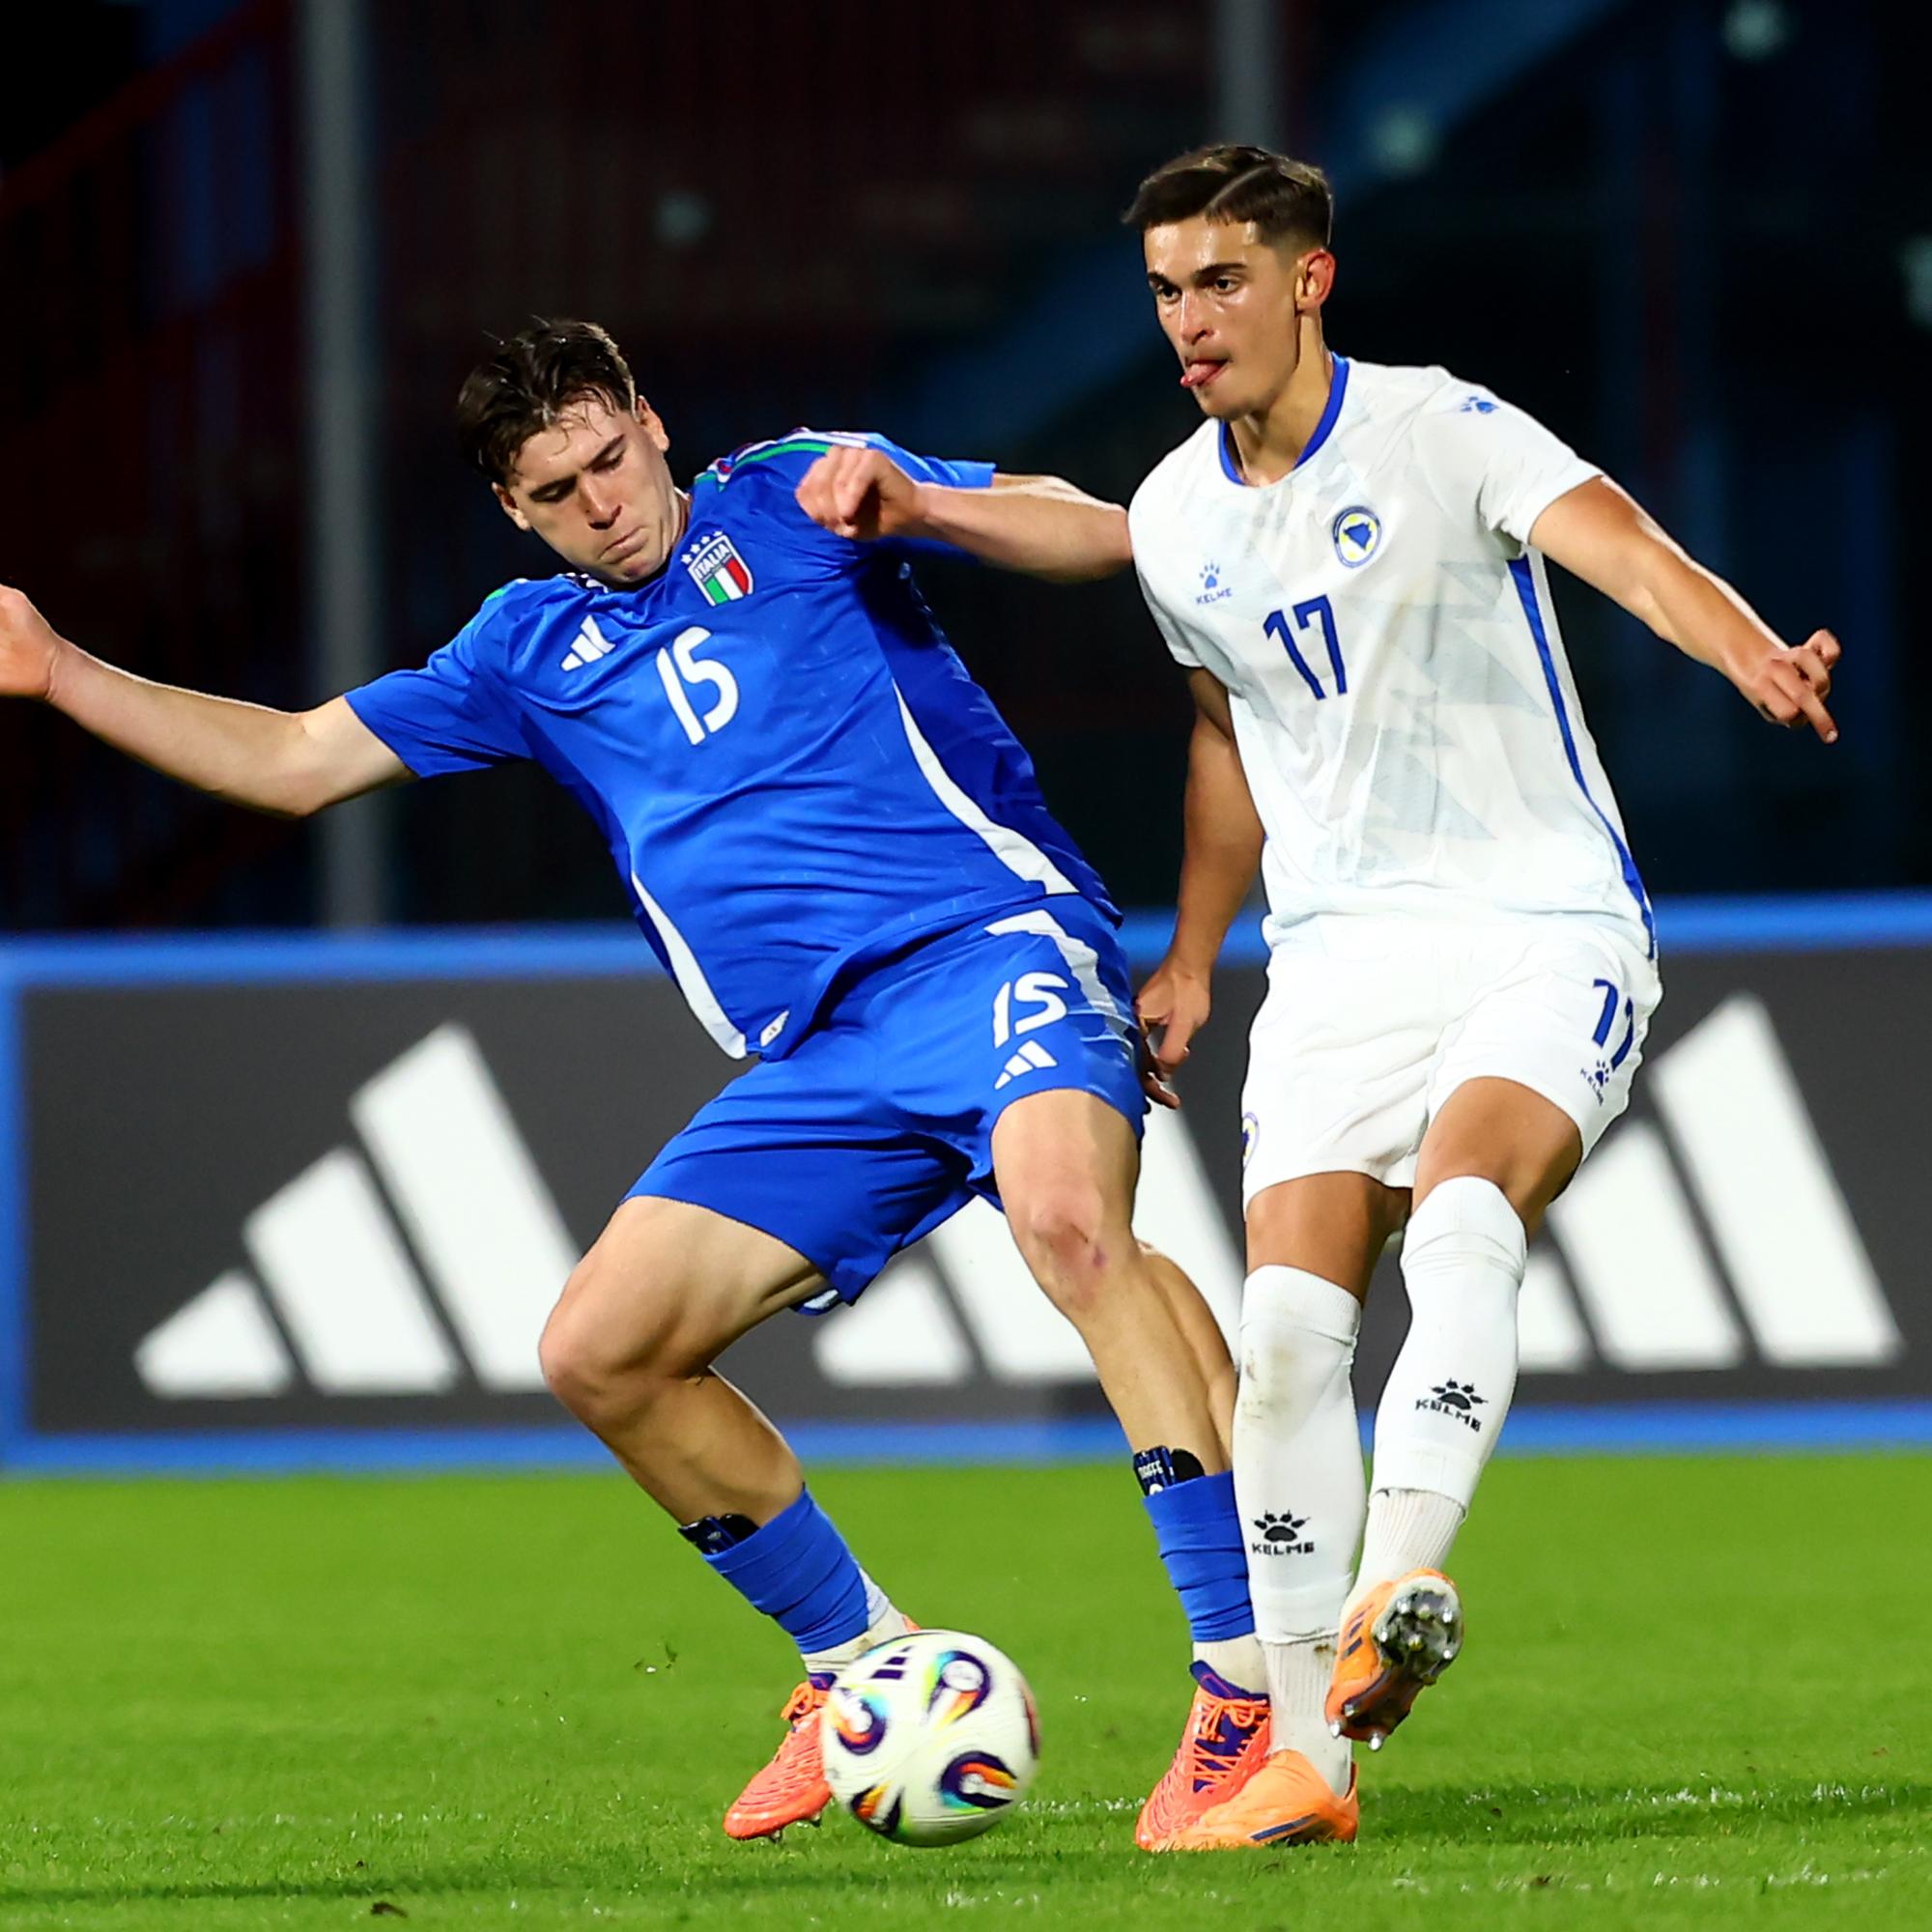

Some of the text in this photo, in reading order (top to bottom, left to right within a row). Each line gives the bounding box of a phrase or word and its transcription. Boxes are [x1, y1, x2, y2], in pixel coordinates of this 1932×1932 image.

[695, 543, 730, 580] ITALIA
[1263, 593, 1348, 700] 17
[656, 625, 739, 746] 15
[992, 971, 1069, 1049] 15
[1415, 1398, 1482, 1433] KELME
[1252, 1541, 1315, 1556] KELME
